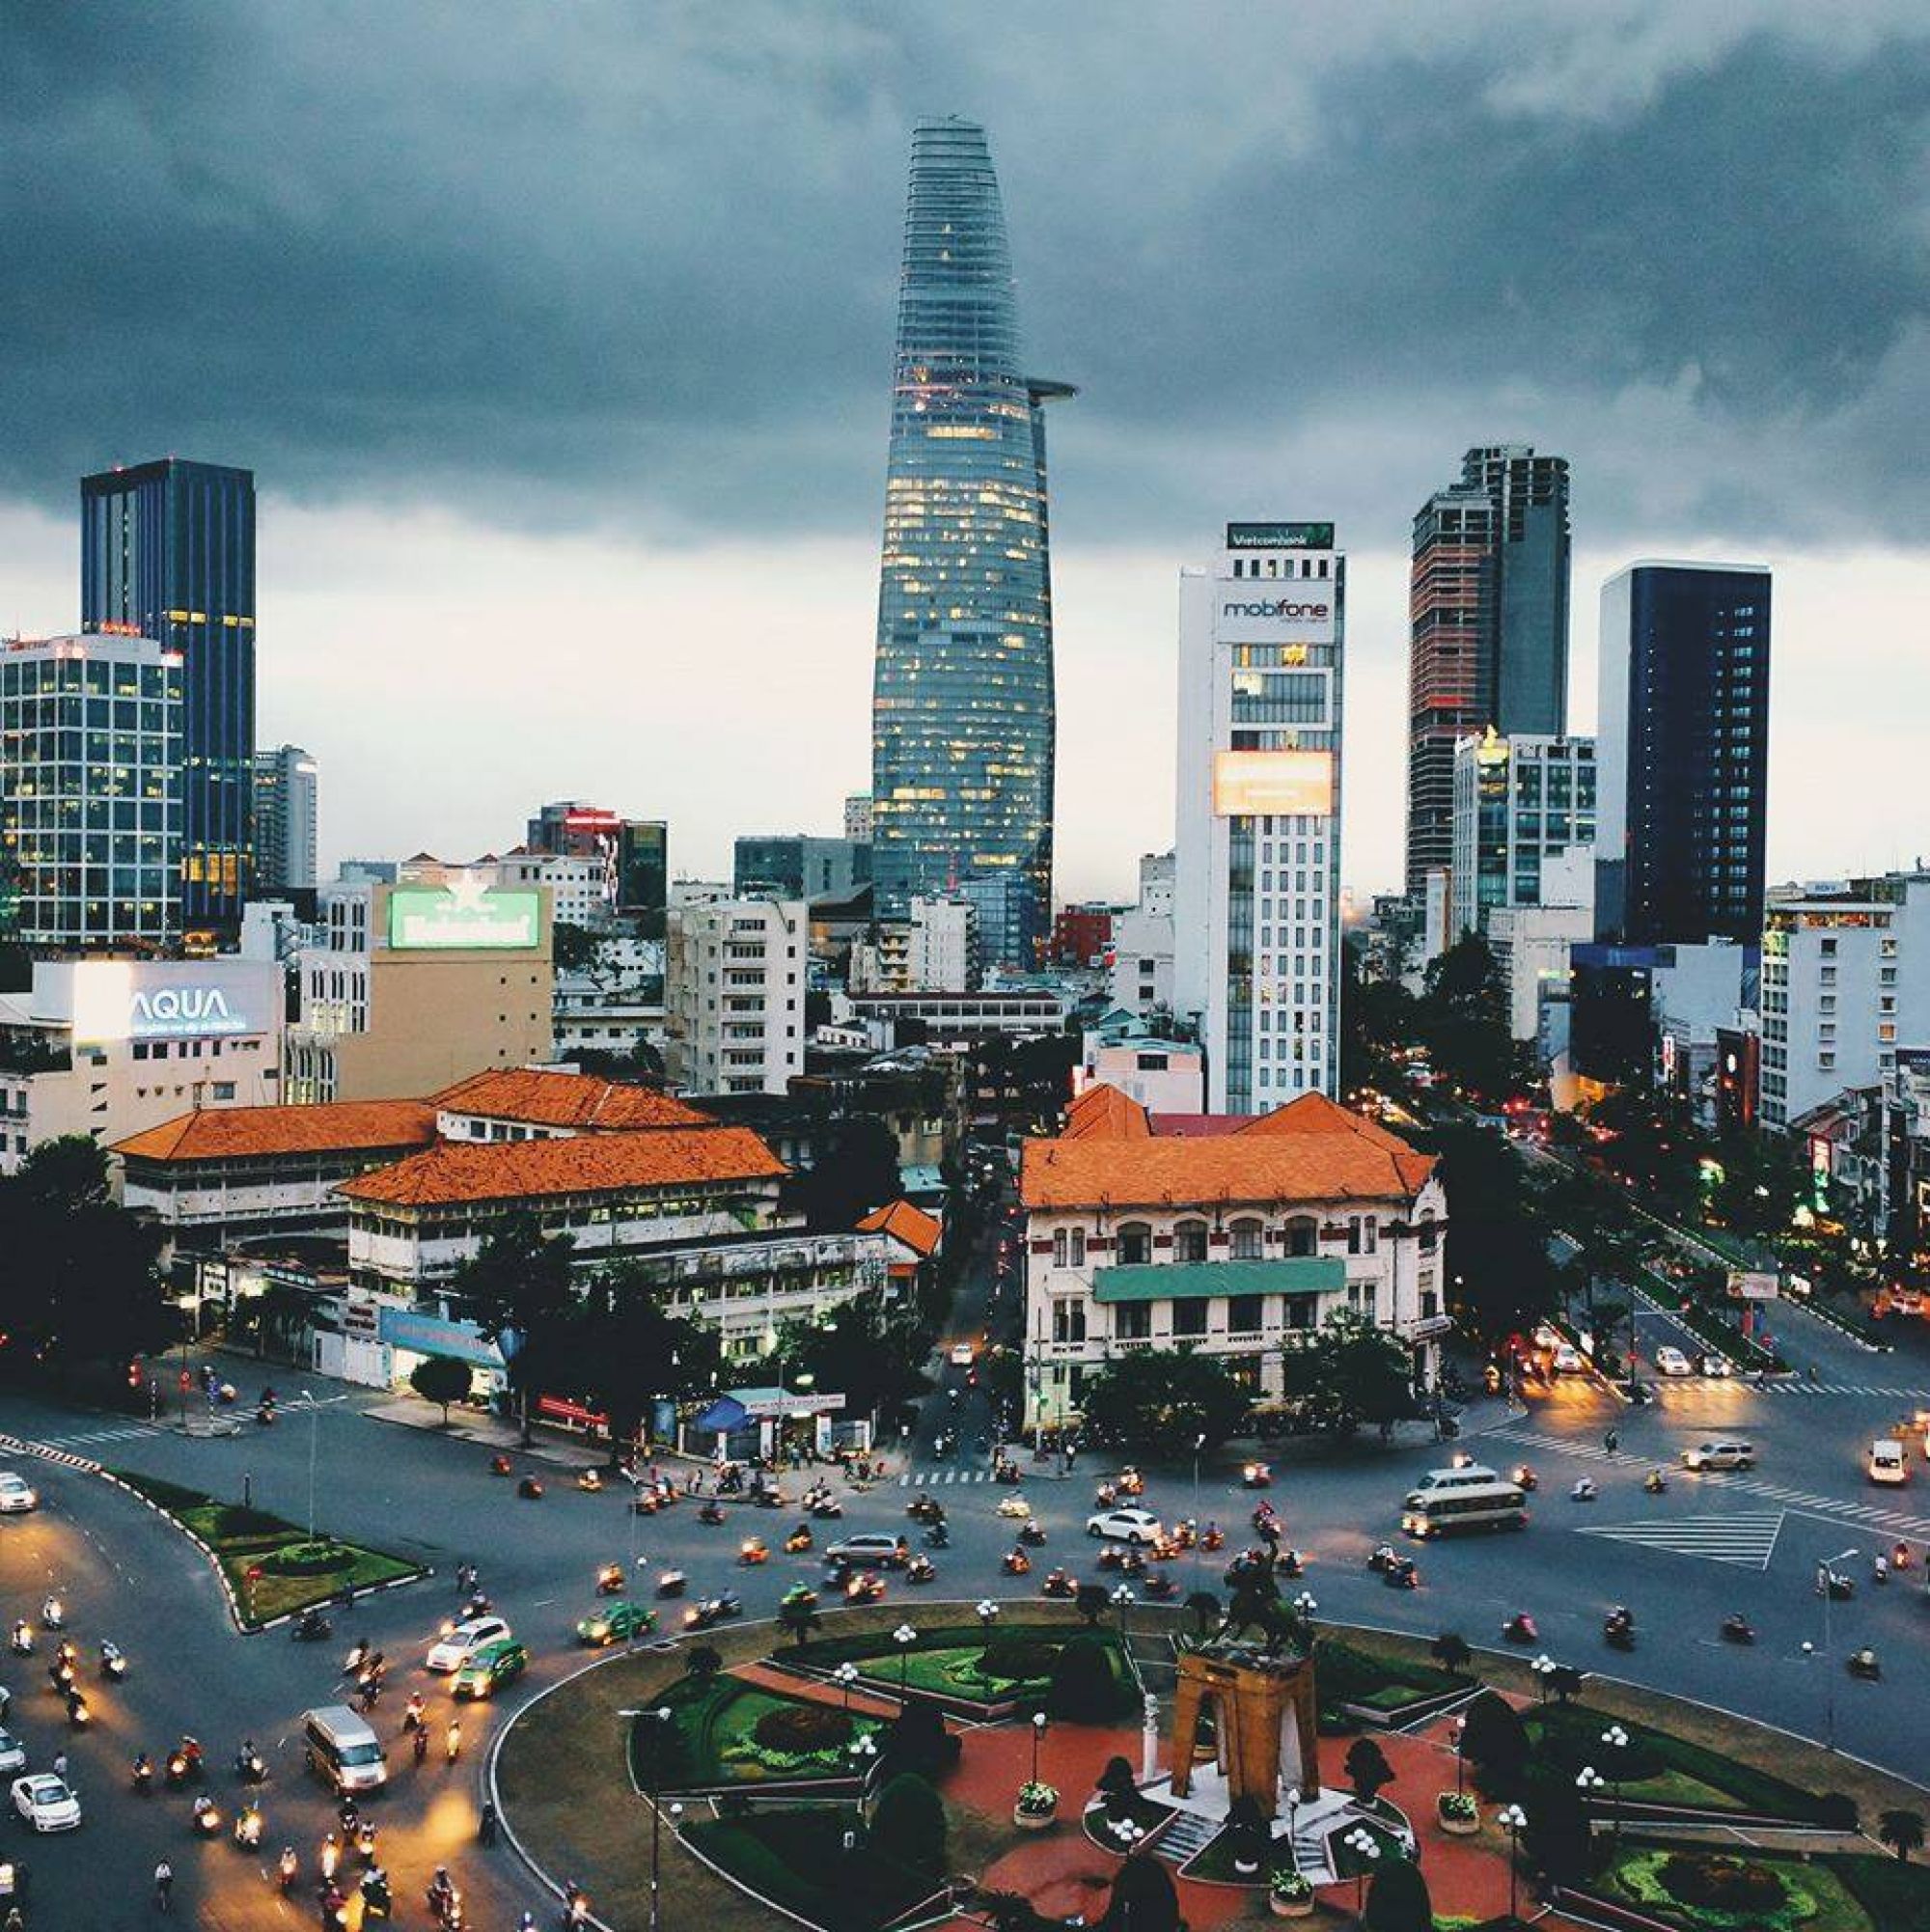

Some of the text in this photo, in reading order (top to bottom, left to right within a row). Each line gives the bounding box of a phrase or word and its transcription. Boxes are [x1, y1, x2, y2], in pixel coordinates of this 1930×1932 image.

[1233, 535, 1307, 546] Vietcombank
[1224, 598, 1328, 616] mobifone
[131, 989, 228, 1019] AQUA
